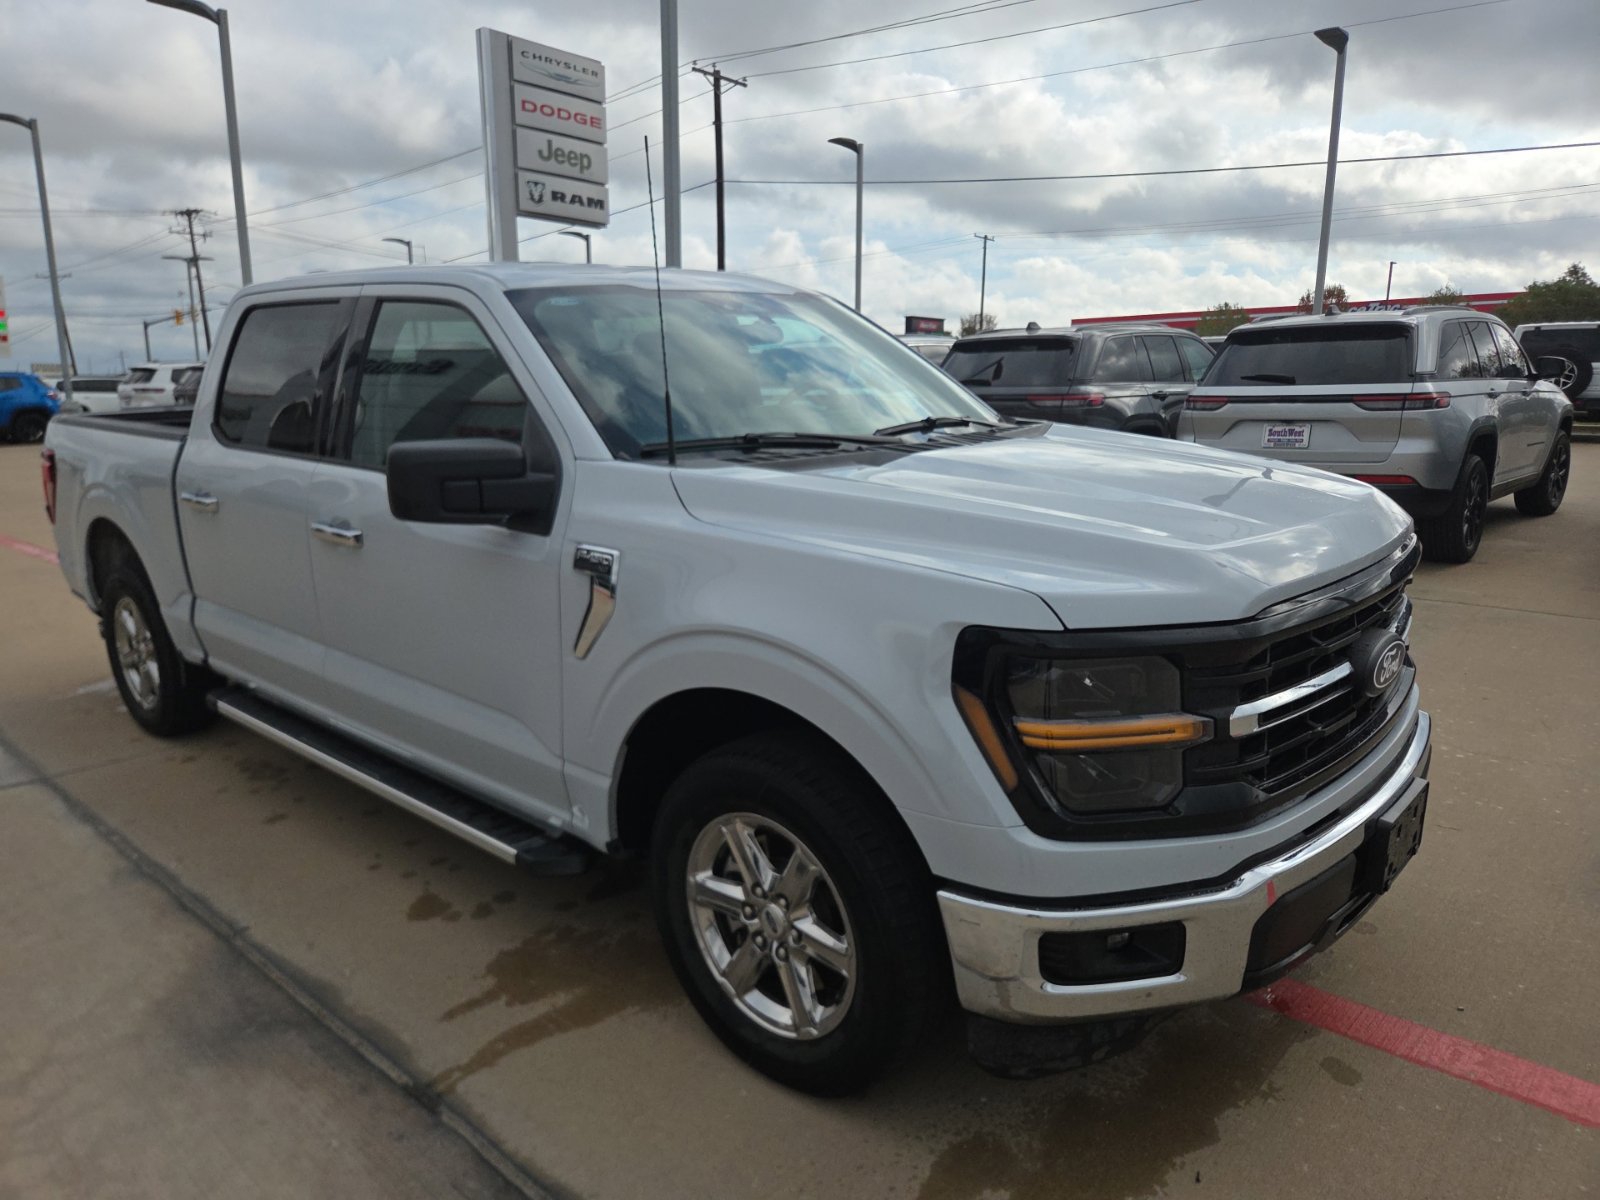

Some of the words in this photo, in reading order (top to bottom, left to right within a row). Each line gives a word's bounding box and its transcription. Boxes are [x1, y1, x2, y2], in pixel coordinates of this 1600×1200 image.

[521, 50, 598, 77] CHRYSLER
[521, 99, 602, 129] DODGE
[538, 139, 592, 174] Jeep
[551, 190, 605, 210] RAM
[1380, 648, 1401, 683] Ford
